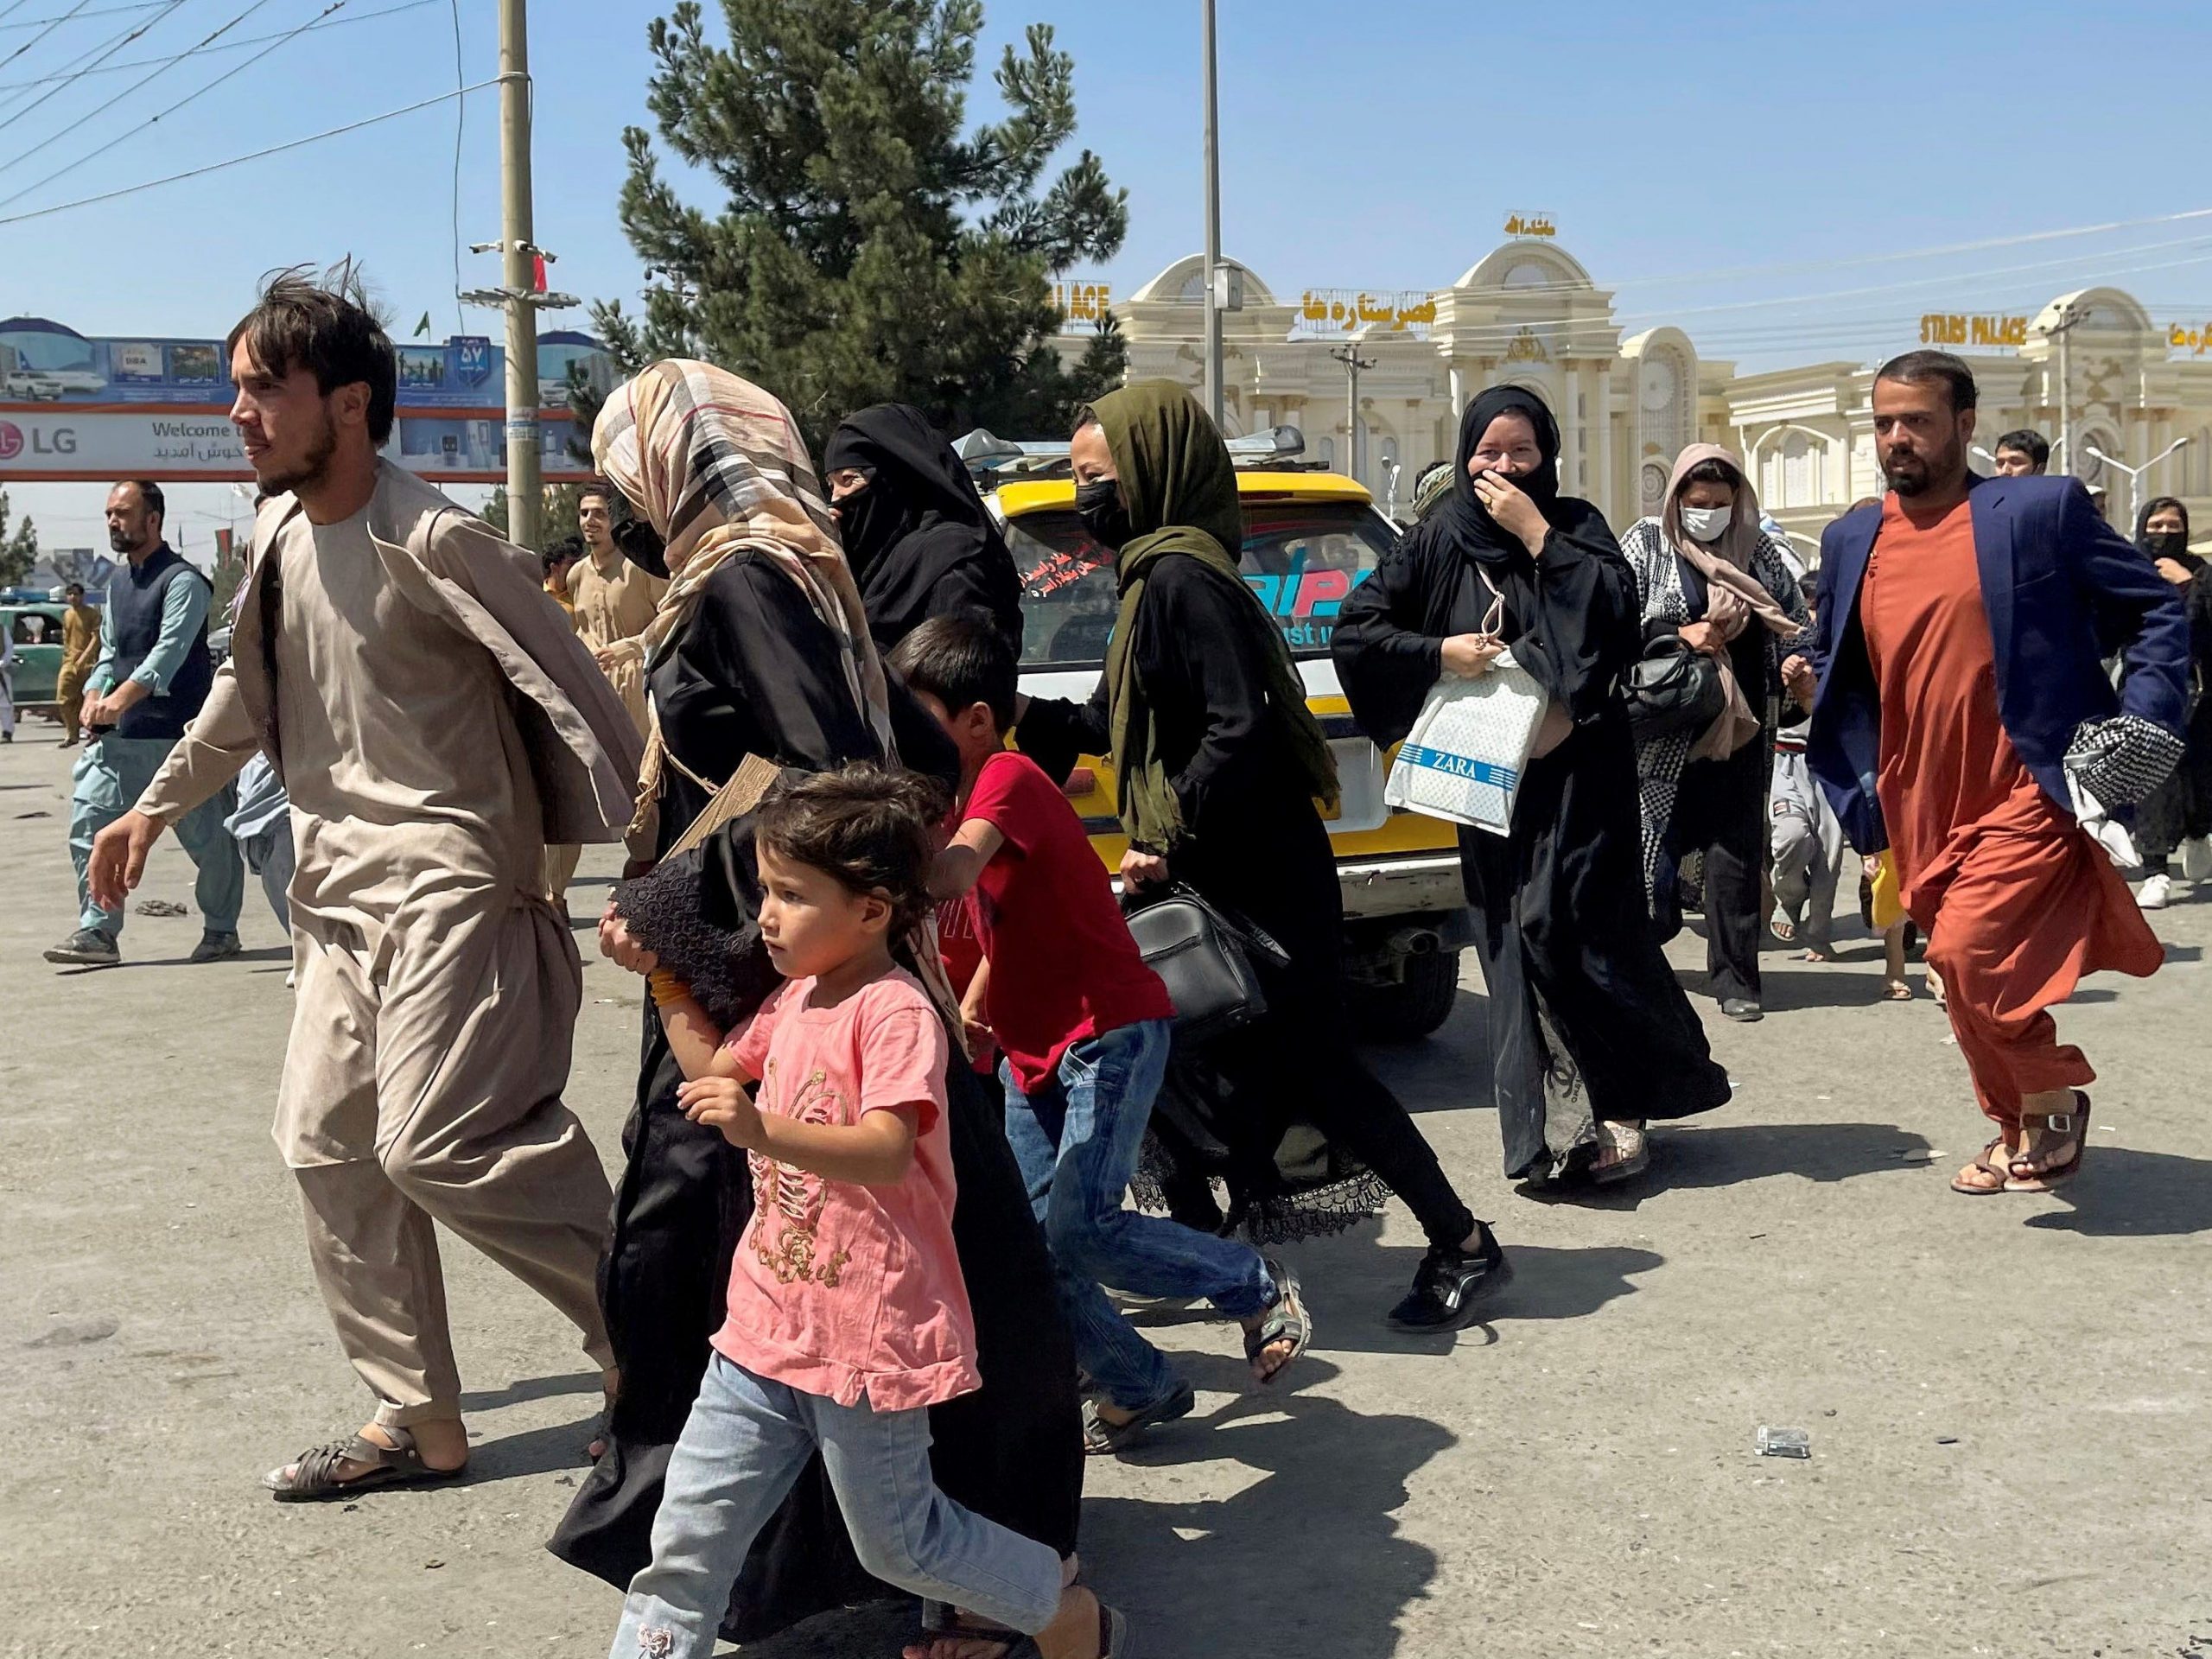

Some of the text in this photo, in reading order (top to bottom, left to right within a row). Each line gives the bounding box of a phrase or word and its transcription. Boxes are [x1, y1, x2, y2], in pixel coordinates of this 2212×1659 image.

[1302, 290, 1437, 331] قصر ستاره ها
[1920, 314, 2027, 345] STARS PALACE
[32, 427, 77, 454] LG
[152, 422, 230, 437] Welcome
[1433, 753, 1477, 779] ZARA
